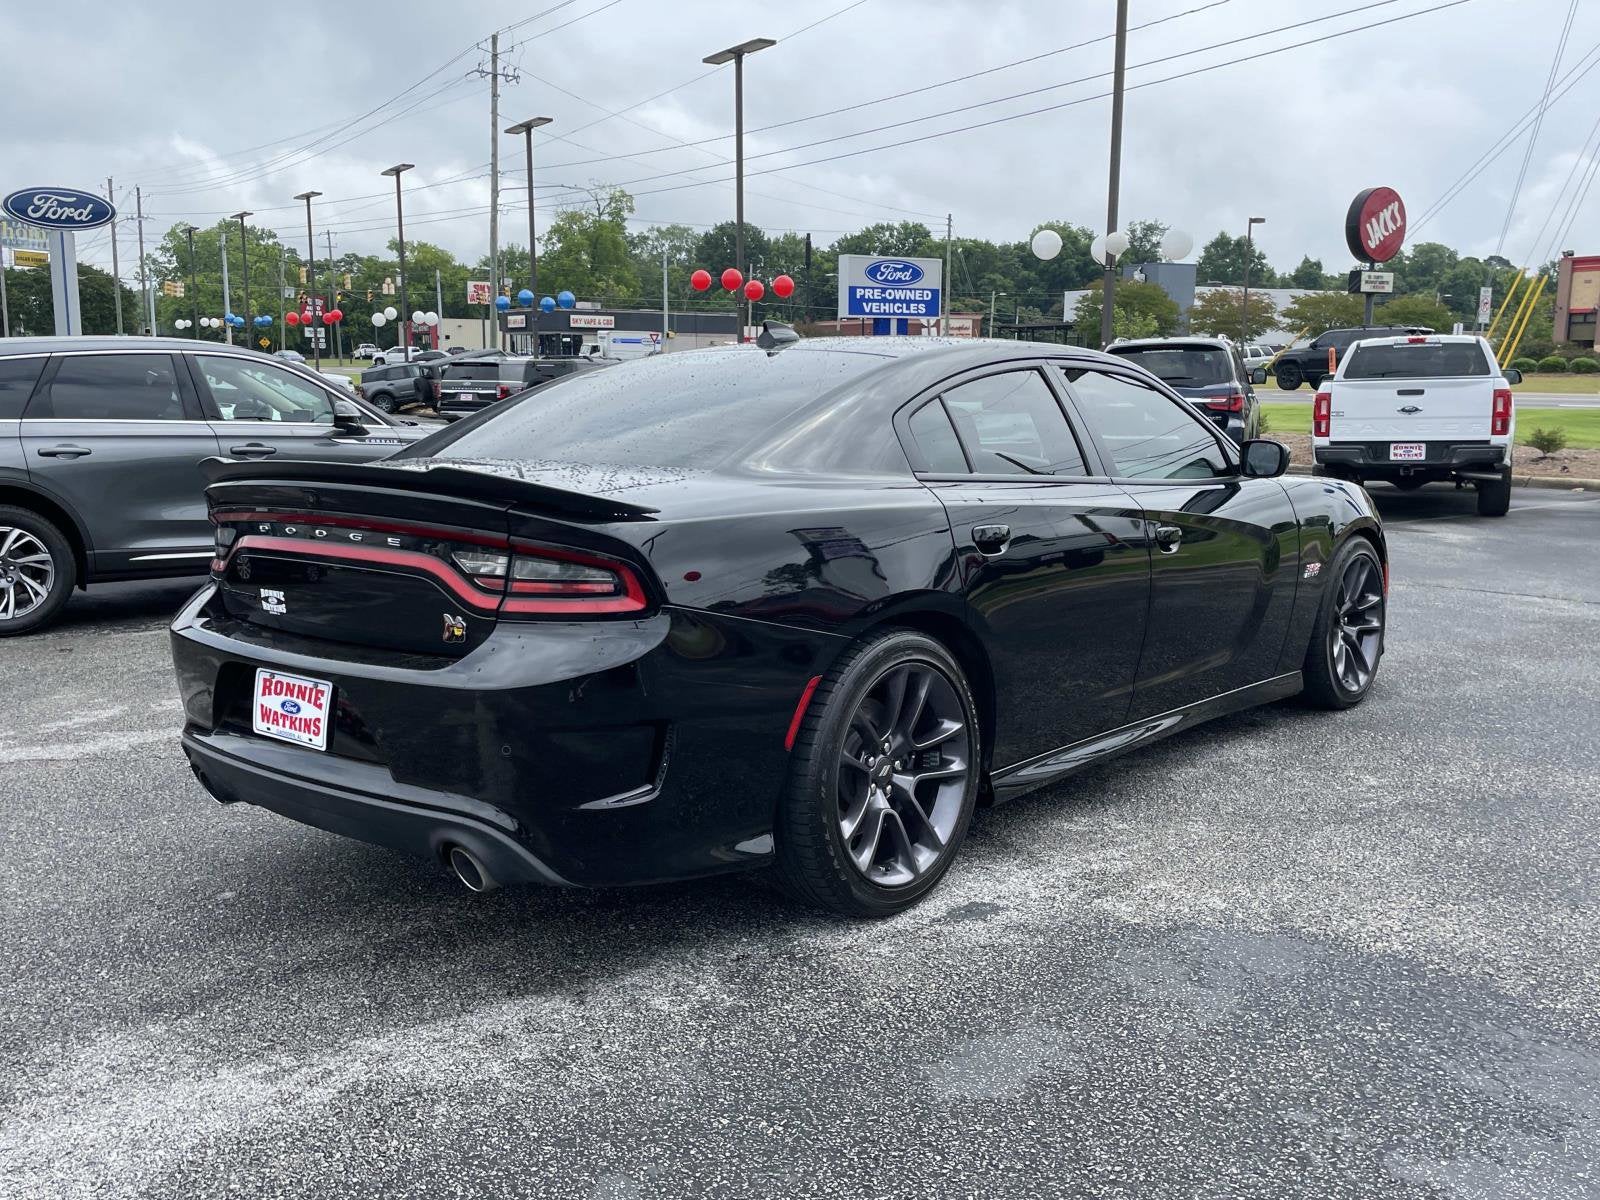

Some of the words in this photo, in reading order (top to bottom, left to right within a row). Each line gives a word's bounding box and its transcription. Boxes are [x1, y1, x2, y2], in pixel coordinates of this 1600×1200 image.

[27, 193, 94, 221] Ford
[876, 263, 913, 281] Ford
[856, 288, 932, 301] PRE-OWNED
[862, 302, 926, 314] VEHICLES
[571, 317, 583, 325] SKY
[583, 318, 597, 326] VAPE
[259, 524, 401, 546] DODGE
[261, 677, 325, 711] RONNIE
[283, 701, 298, 714] Ford
[260, 703, 322, 737] WATKINS
